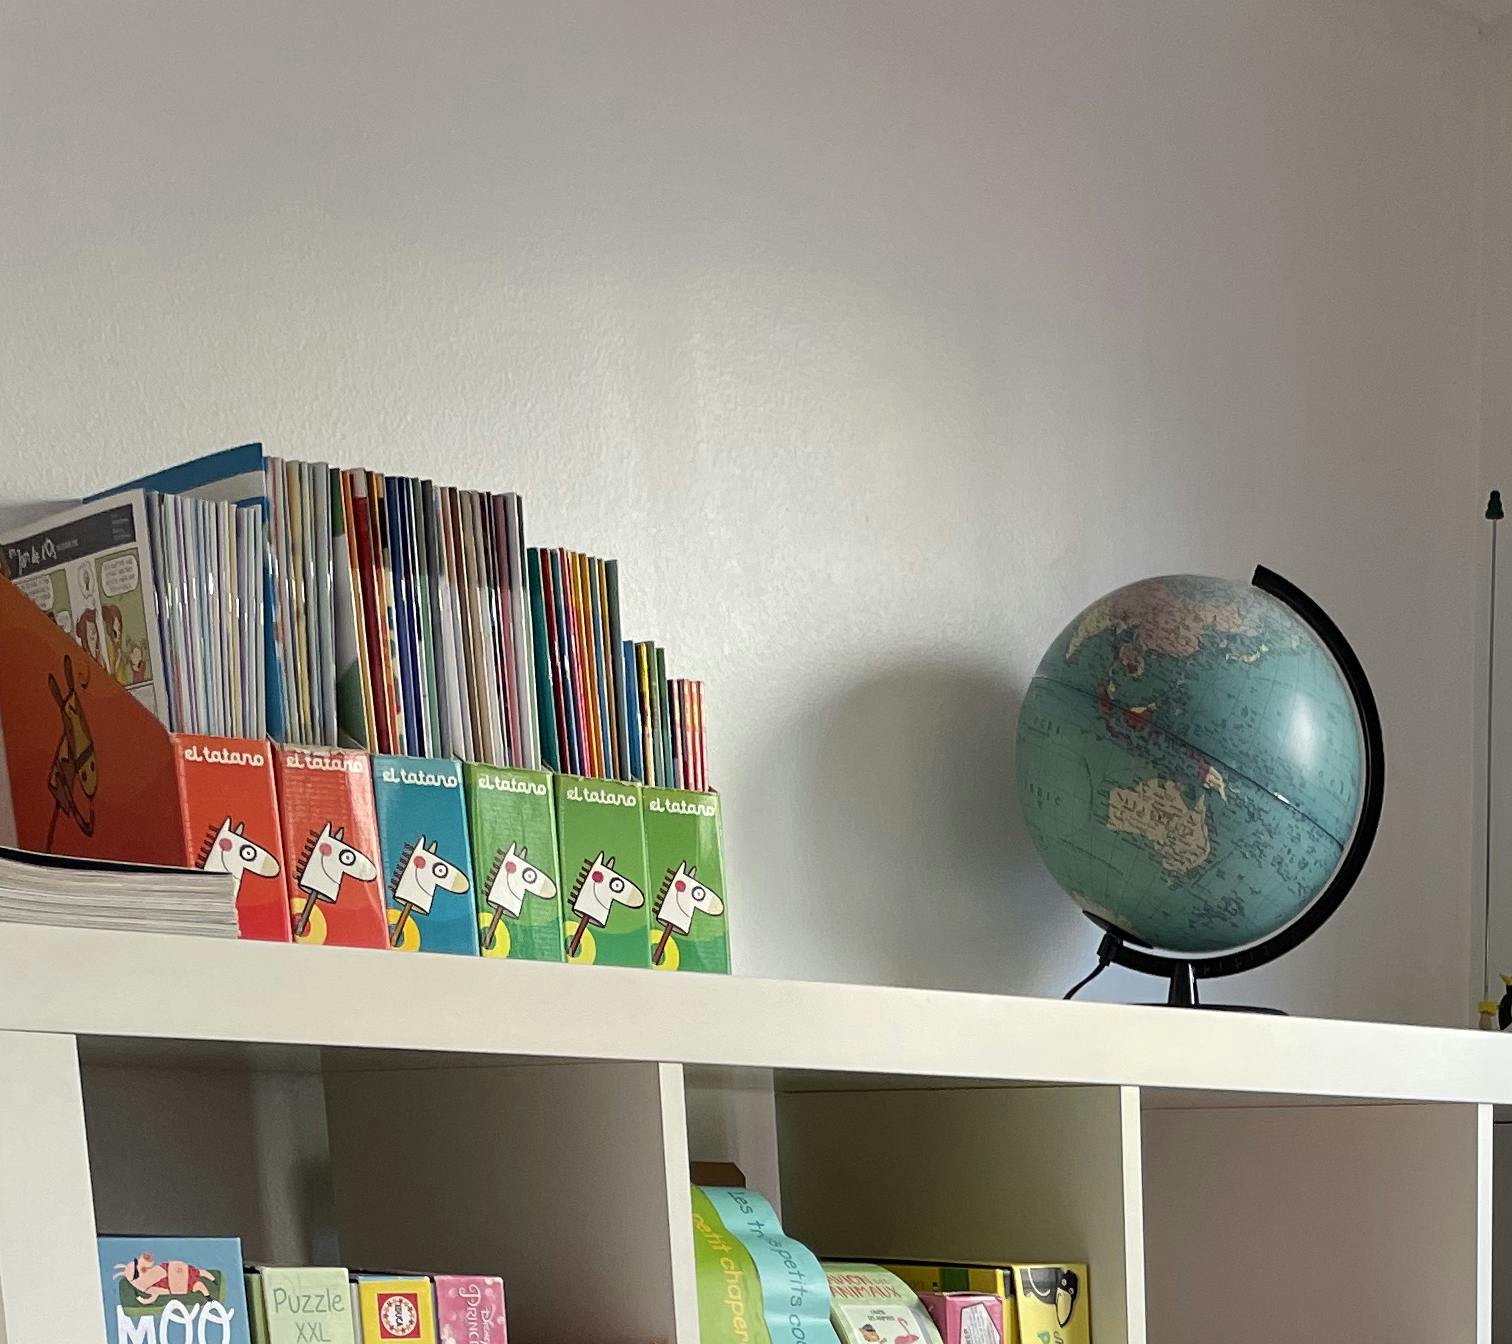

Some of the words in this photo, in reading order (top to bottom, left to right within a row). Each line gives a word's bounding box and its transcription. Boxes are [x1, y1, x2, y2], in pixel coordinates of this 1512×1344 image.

[183, 745, 201, 762] el
[201, 747, 265, 767] tatano
[285, 754, 305, 769] el
[305, 755, 363, 773] tatano
[382, 767, 400, 783] el
[400, 769, 458, 788] tatano
[478, 774, 495, 789] el
[495, 776, 547, 796] tatano
[566, 786, 583, 801] el
[583, 788, 637, 807] tatano
[649, 798, 664, 812] el
[664, 799, 716, 816] tatano
[727, 1189, 753, 1215] Les
[273, 1287, 345, 1314] Puzzle
[295, 1321, 332, 1344] XXL
